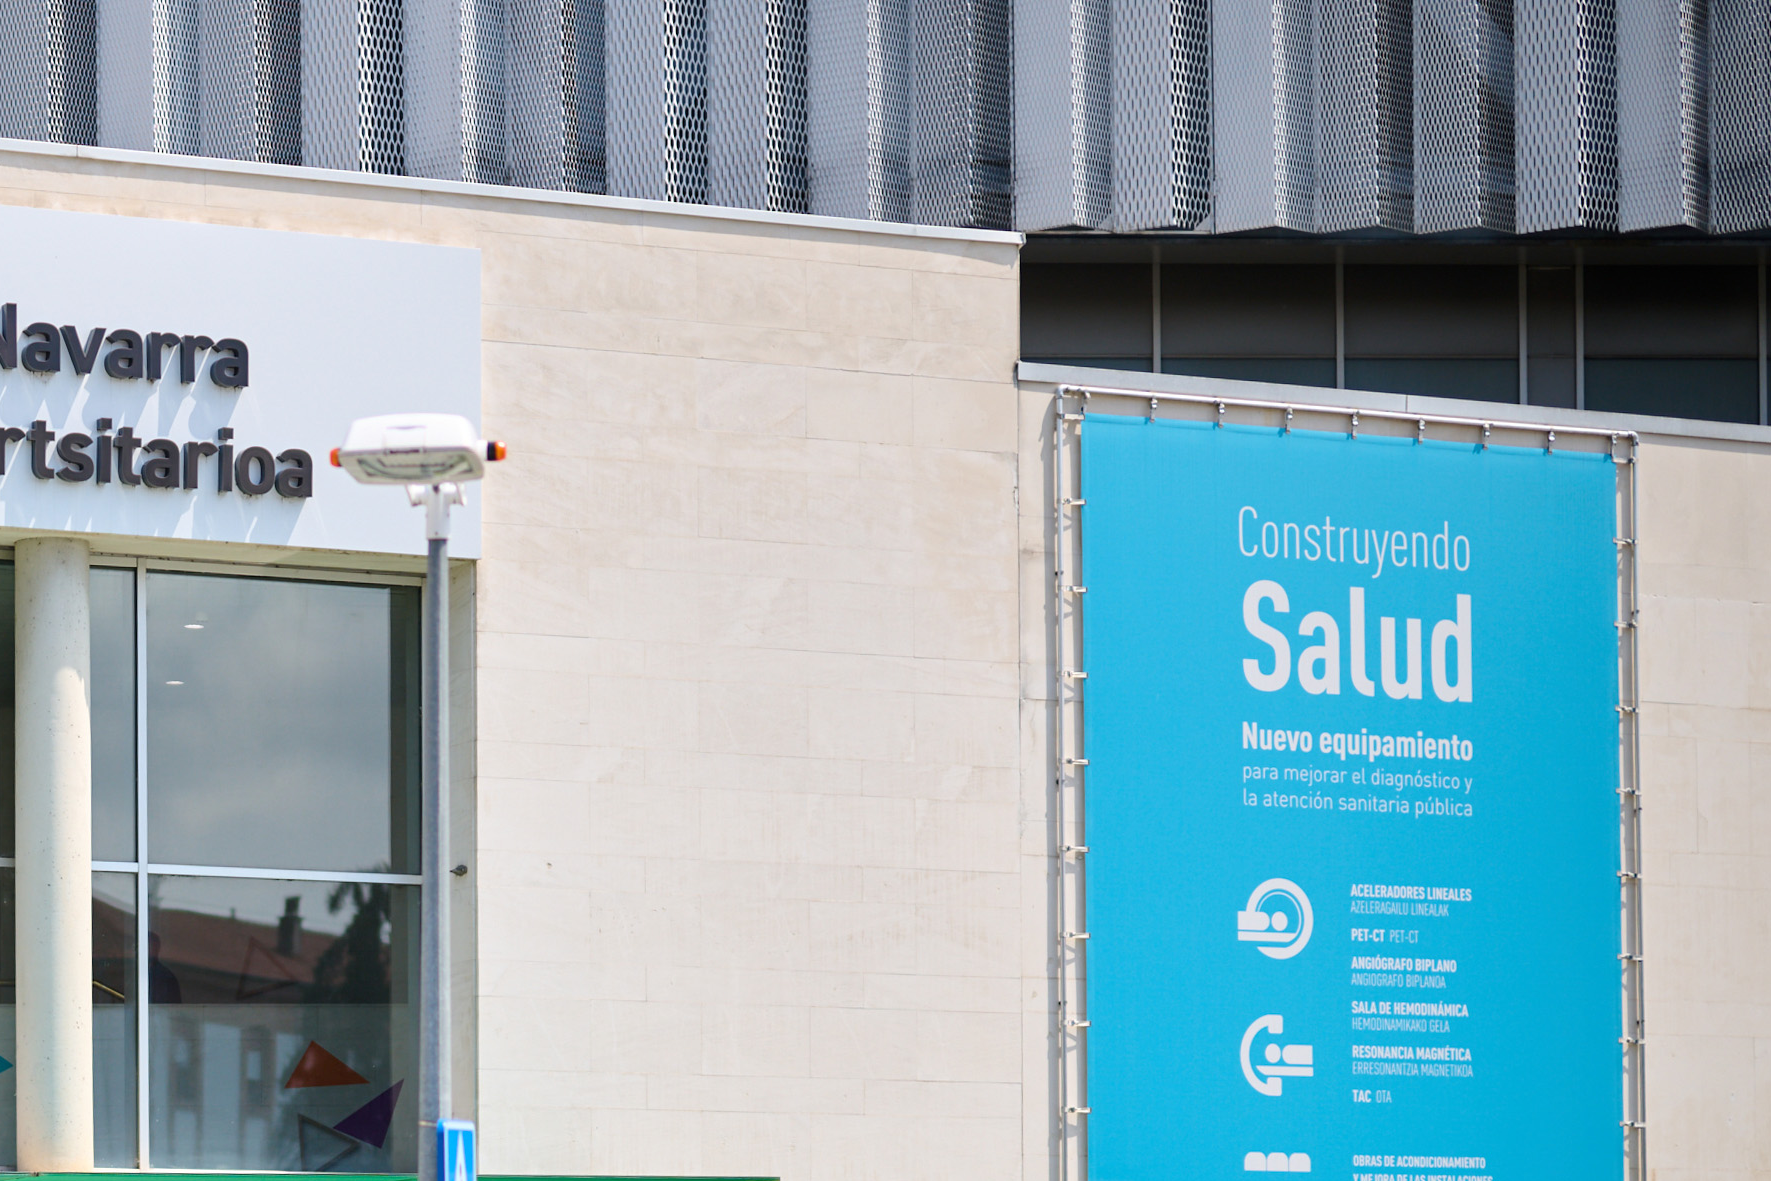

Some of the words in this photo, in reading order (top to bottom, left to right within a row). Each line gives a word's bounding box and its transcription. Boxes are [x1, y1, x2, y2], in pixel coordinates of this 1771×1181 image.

[1238, 506, 1470, 579] Construyendo
[1242, 579, 1473, 703] Salud
[1242, 721, 1313, 753] Nuevo
[1319, 728, 1473, 762] equipamiento
[1243, 765, 1278, 783] para
[1284, 764, 1347, 787] mejorar
[1352, 767, 1366, 784] el
[1371, 768, 1460, 791] diagnóstico
[1464, 777, 1473, 794] y
[1243, 788, 1257, 806] la
[1263, 790, 1333, 810] atención
[1338, 794, 1409, 813] sanitaria
[1415, 797, 1473, 819] pública
[1350, 884, 1425, 899] ACELERADORES
[1427, 887, 1472, 901] LINEALES
[1350, 900, 1408, 915] AZELERAGAILU
[1411, 903, 1449, 916] LINEALAK
[1351, 928, 1385, 942] PET-CT
[1390, 929, 1419, 943] PET-CT
[1351, 954, 1413, 971] ANGIÓGRAFO
[1415, 959, 1457, 972] BIPLANO
[1351, 973, 1404, 988] ANGIOGRAFO
[1406, 975, 1446, 989] BIPLANOA
[1352, 1001, 1377, 1014] SALA
[1379, 1002, 1391, 1015] DE
[1394, 1001, 1469, 1017] HEMODINÁMICA
[1352, 1017, 1427, 1032] HEMODINAMIKAKO
[1429, 1019, 1450, 1033] GELA
[1352, 1045, 1414, 1060] RESONANCIA
[1416, 1045, 1472, 1061] MAGNÉTICA
[1352, 1061, 1419, 1076] ERRESONANTZIA
[1421, 1063, 1473, 1077] MAGNETIKOA
[1352, 1089, 1372, 1103] TAC
[1376, 1090, 1392, 1103] OTA
[1353, 1155, 1382, 1167] OBRAS
[1384, 1155, 1395, 1167] DE
[1397, 1156, 1486, 1169] ACONDICIONAMIENTO
